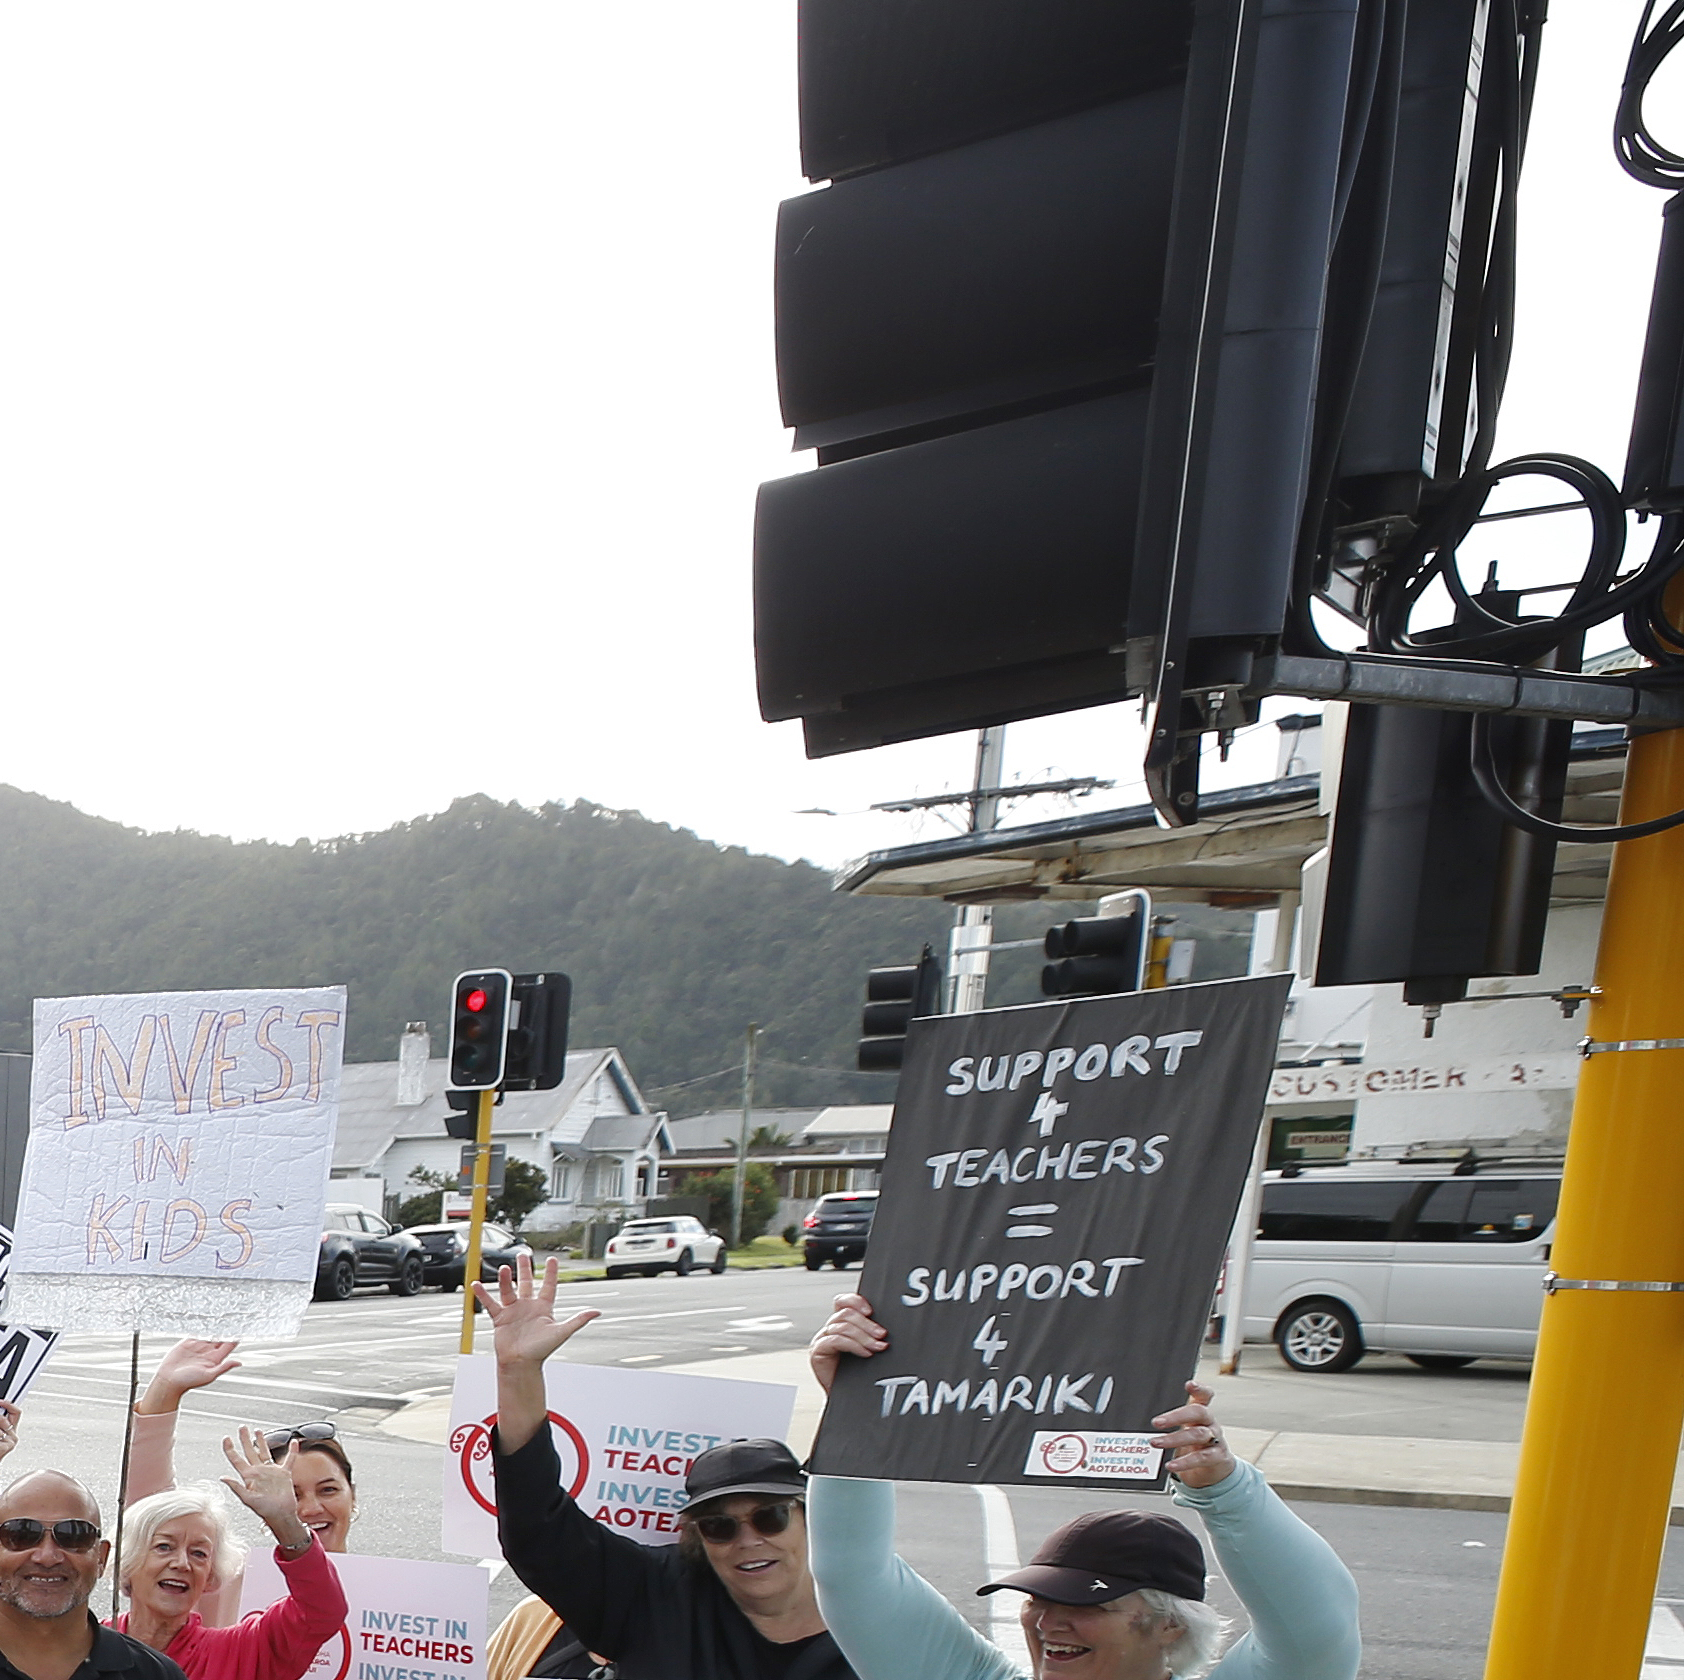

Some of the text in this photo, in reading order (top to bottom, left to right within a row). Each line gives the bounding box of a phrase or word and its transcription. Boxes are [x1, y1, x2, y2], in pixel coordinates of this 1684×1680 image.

[58, 1006, 340, 1130] INVEST
[945, 1028, 1203, 1097] SUPPORT
[1028, 1090, 1068, 1138] 4
[133, 1134, 192, 1185] IN
[926, 1133, 1169, 1190] TEACHERS
[86, 1193, 254, 1270] KIDS
[902, 1256, 1144, 1308] SUPPORT
[973, 1316, 1007, 1366] 4
[875, 1373, 1114, 1418] TAMARIKI
[607, 1424, 720, 1454] INVEST
[1090, 1457, 1130, 1465] INVEST
[1093, 1446, 1150, 1454] TEACHERS
[1095, 1437, 1151, 1446] INVEST IN
[1087, 1465, 1150, 1474] AOTEAROA
[598, 1481, 690, 1509] INVES
[362, 1610, 467, 1640] INVEST IN
[361, 1632, 473, 1664] TEACHERS
